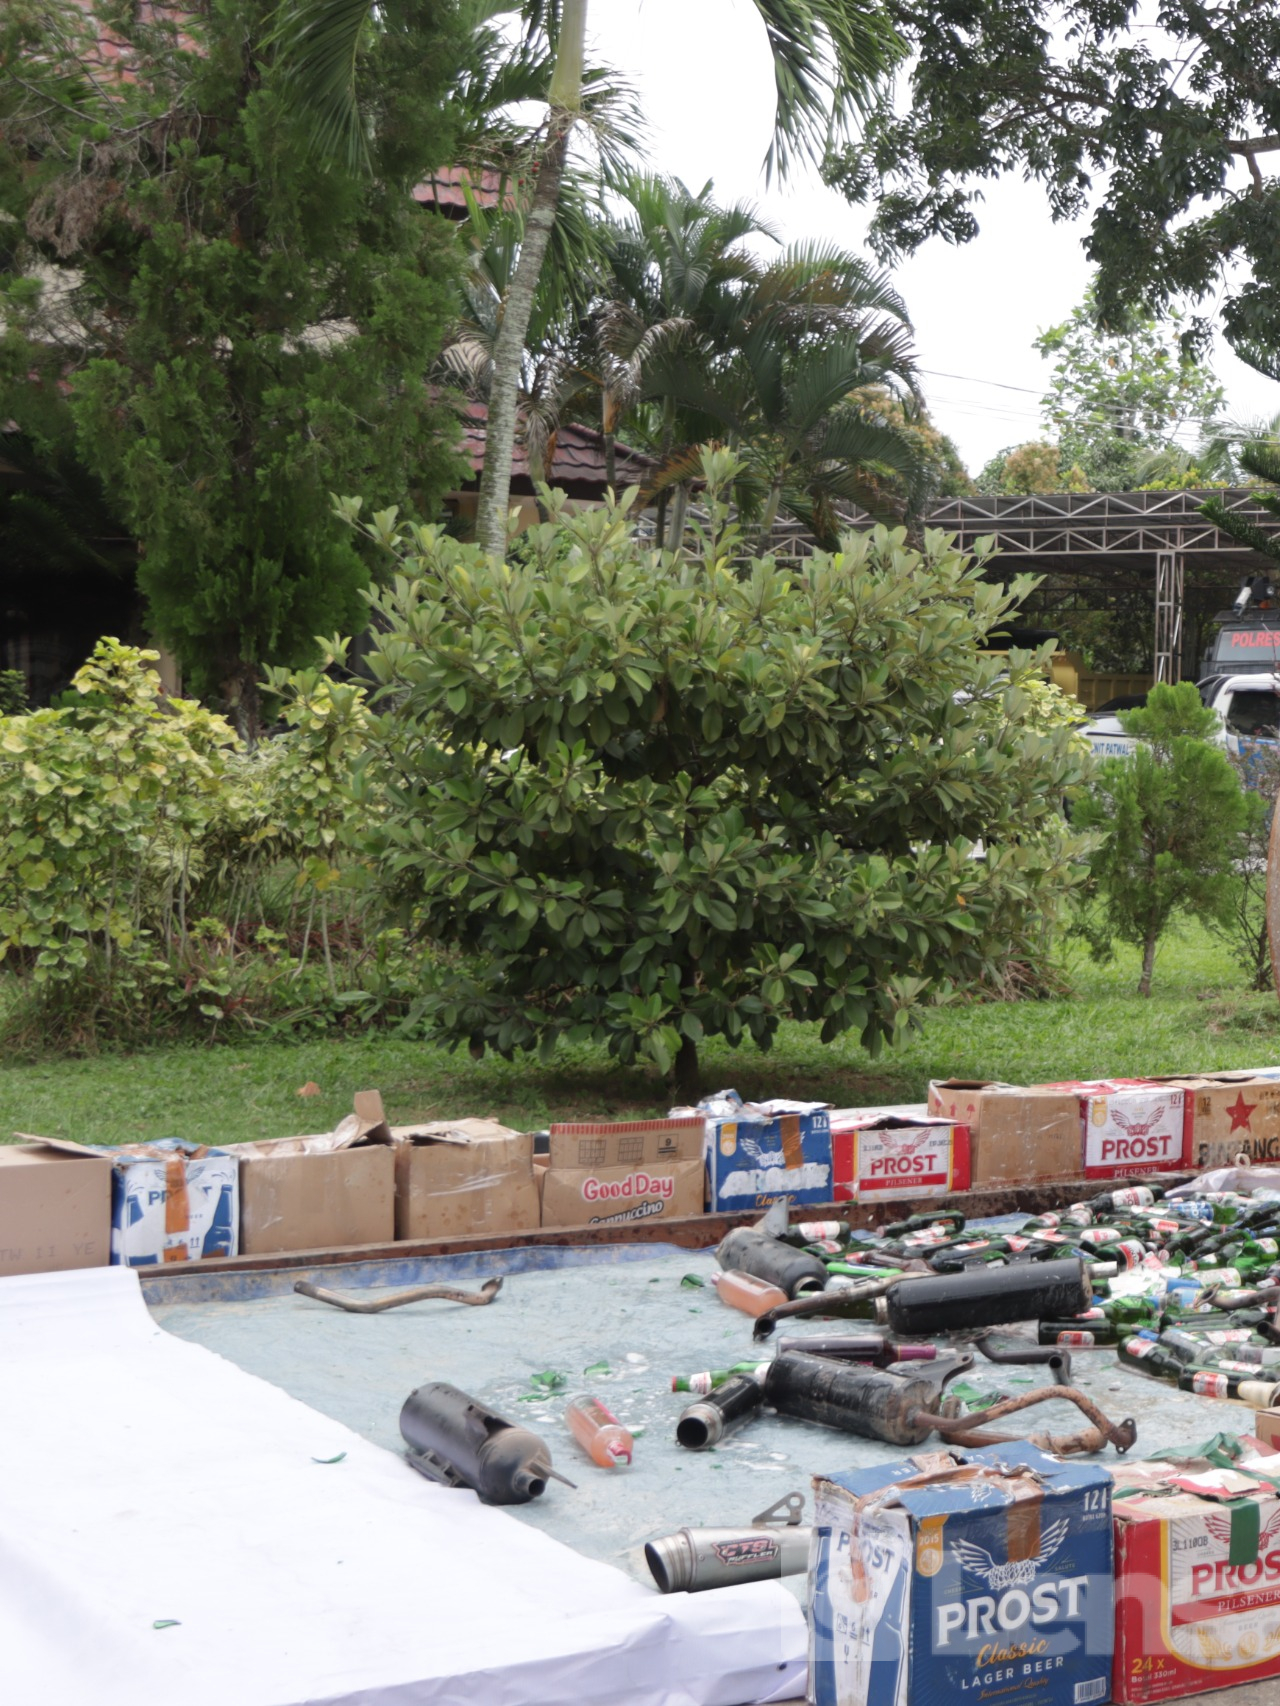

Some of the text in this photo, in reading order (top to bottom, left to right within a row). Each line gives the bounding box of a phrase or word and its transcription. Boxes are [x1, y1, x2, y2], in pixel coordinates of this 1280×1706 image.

[1101, 1135, 1172, 1160] PROST
[870, 1154, 938, 1176] PROST
[1114, 1165, 1160, 1178] PILSENER
[886, 1177, 922, 1187] PILSENER
[919, 1534, 940, 1547] 2015
[837, 1531, 895, 1574] POST
[935, 1575, 1089, 1648] PROST
[1238, 1621, 1258, 1630] BEER
[975, 1637, 1049, 1668] Classic
[962, 1656, 1064, 1690] LAGER BEER
[1131, 1656, 1153, 1674] 24
